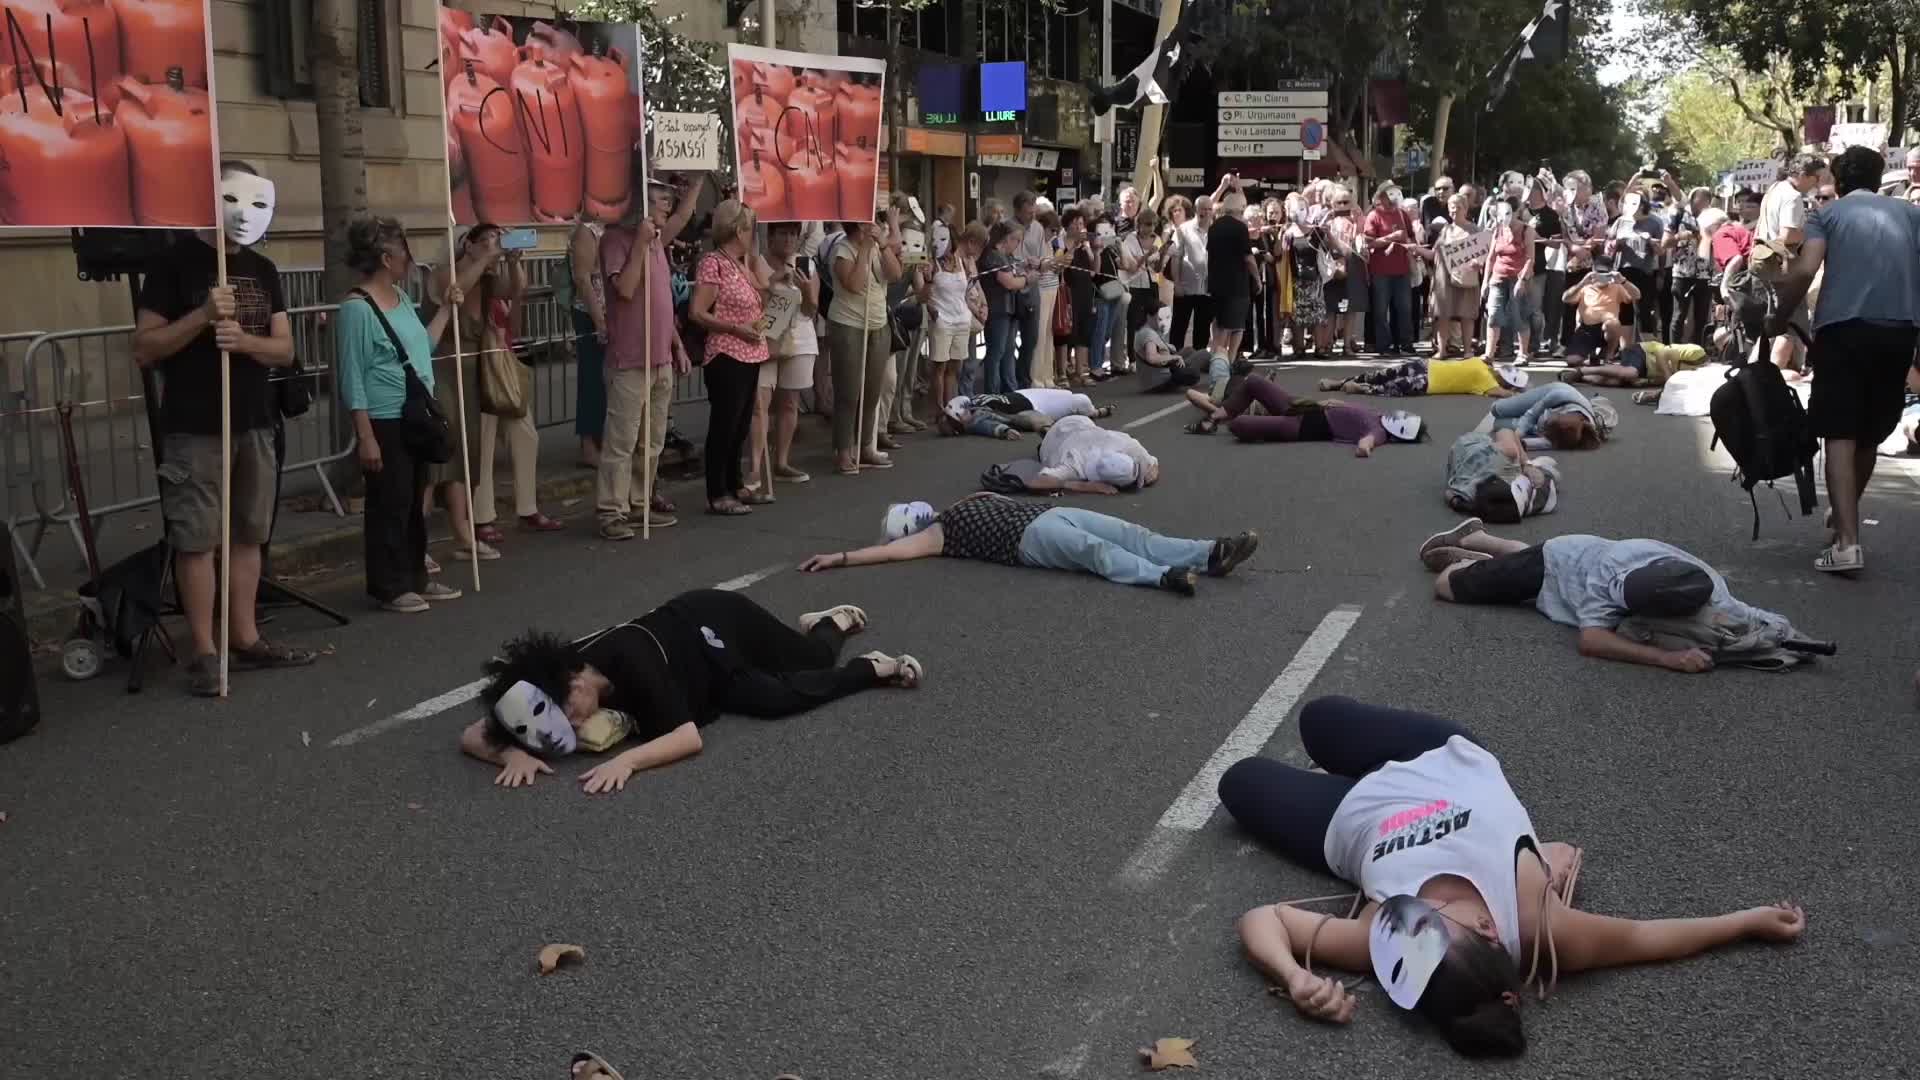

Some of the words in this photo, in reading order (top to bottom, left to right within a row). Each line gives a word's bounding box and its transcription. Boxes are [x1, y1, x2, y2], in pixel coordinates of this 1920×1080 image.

[1234, 94, 1242, 102] C.
[1246, 94, 1261, 102] Pau
[985, 111, 1016, 121] LLIURE
[478, 87, 567, 157] CNI
[1234, 128, 1247, 136] Via
[775, 106, 836, 171] CNI
[1233, 144, 1251, 152] Port
[1372, 809, 1472, 862] ACTIVE
